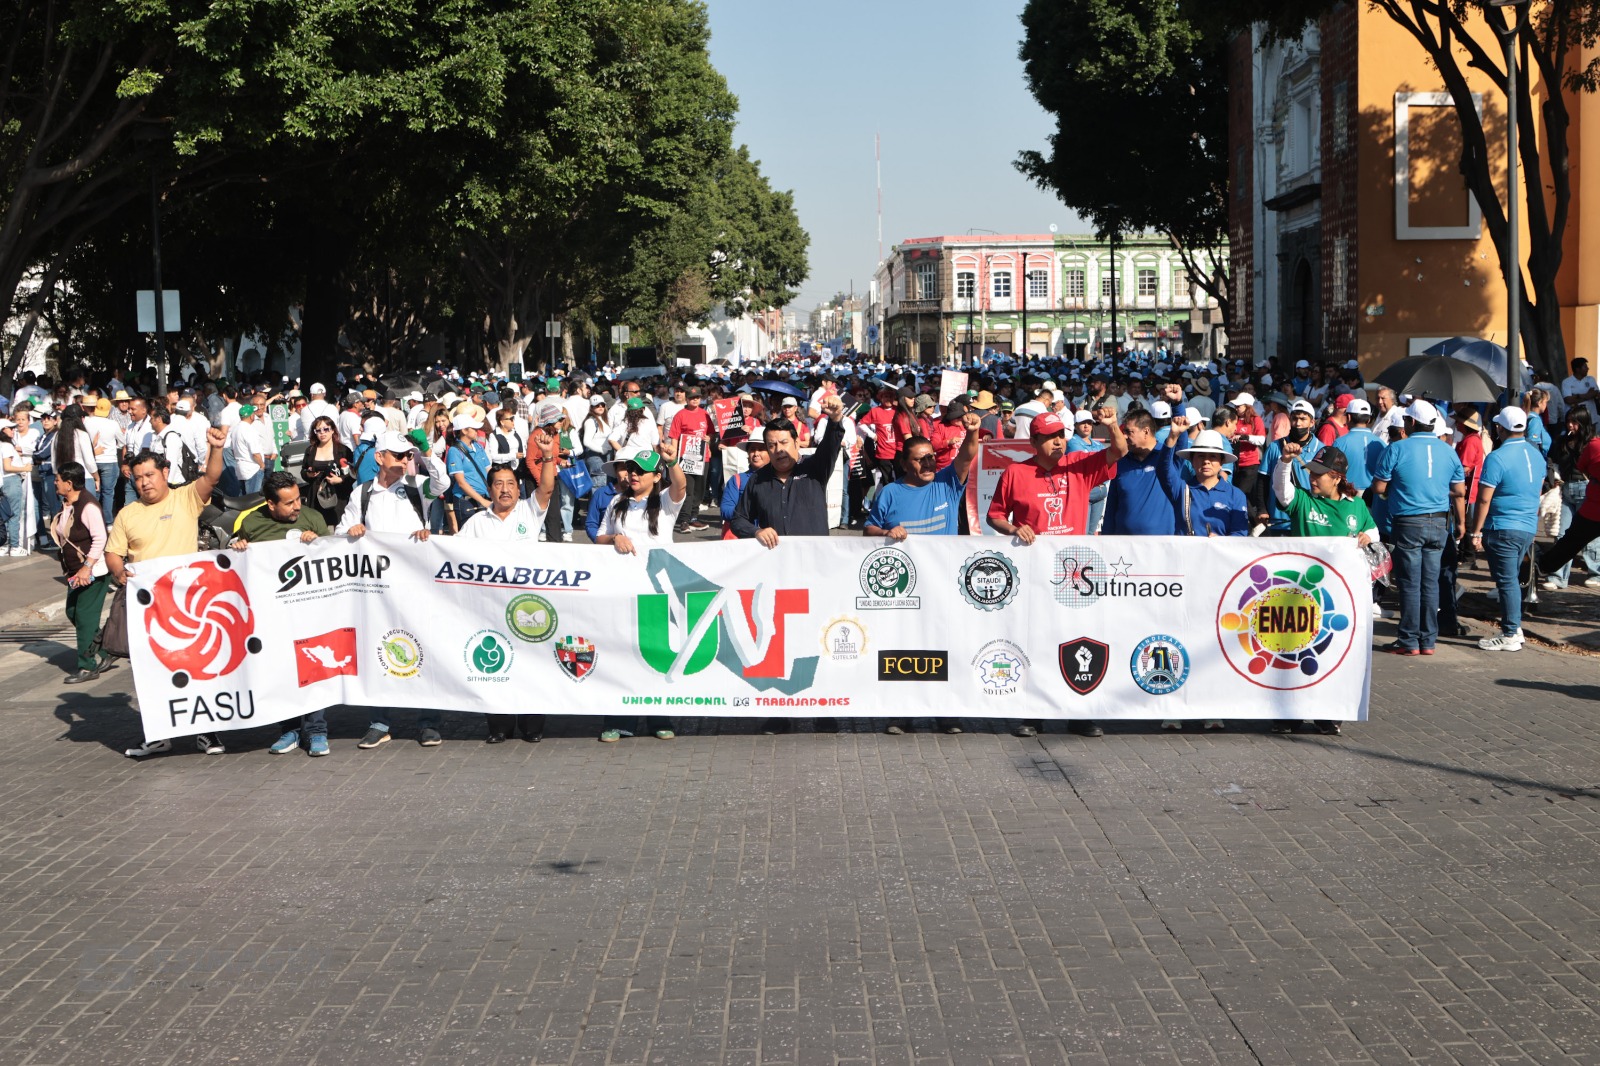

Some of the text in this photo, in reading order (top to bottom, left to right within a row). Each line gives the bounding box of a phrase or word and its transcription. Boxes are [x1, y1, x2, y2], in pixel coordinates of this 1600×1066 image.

[686, 436, 702, 446] 213
[434, 561, 592, 588] ASPABUAP
[966, 558, 1012, 577] SINDICATO INDEPENDIENTE
[1079, 566, 1182, 597] Sutinaoe
[1258, 605, 1315, 634] ENADI
[382, 629, 414, 640] EJECUTIVO
[414, 638, 424, 668] NACIONAL
[1138, 636, 1182, 650] SINDICATO
[883, 657, 943, 674] FCUP
[1074, 673, 1093, 681] AGT
[1132, 665, 1187, 693] INDEPENDIENTE
[168, 690, 256, 727] FASU
[622, 696, 662, 705] UNION
[666, 697, 727, 706] NACIONAL
[755, 697, 850, 706] TRABAJADORES
